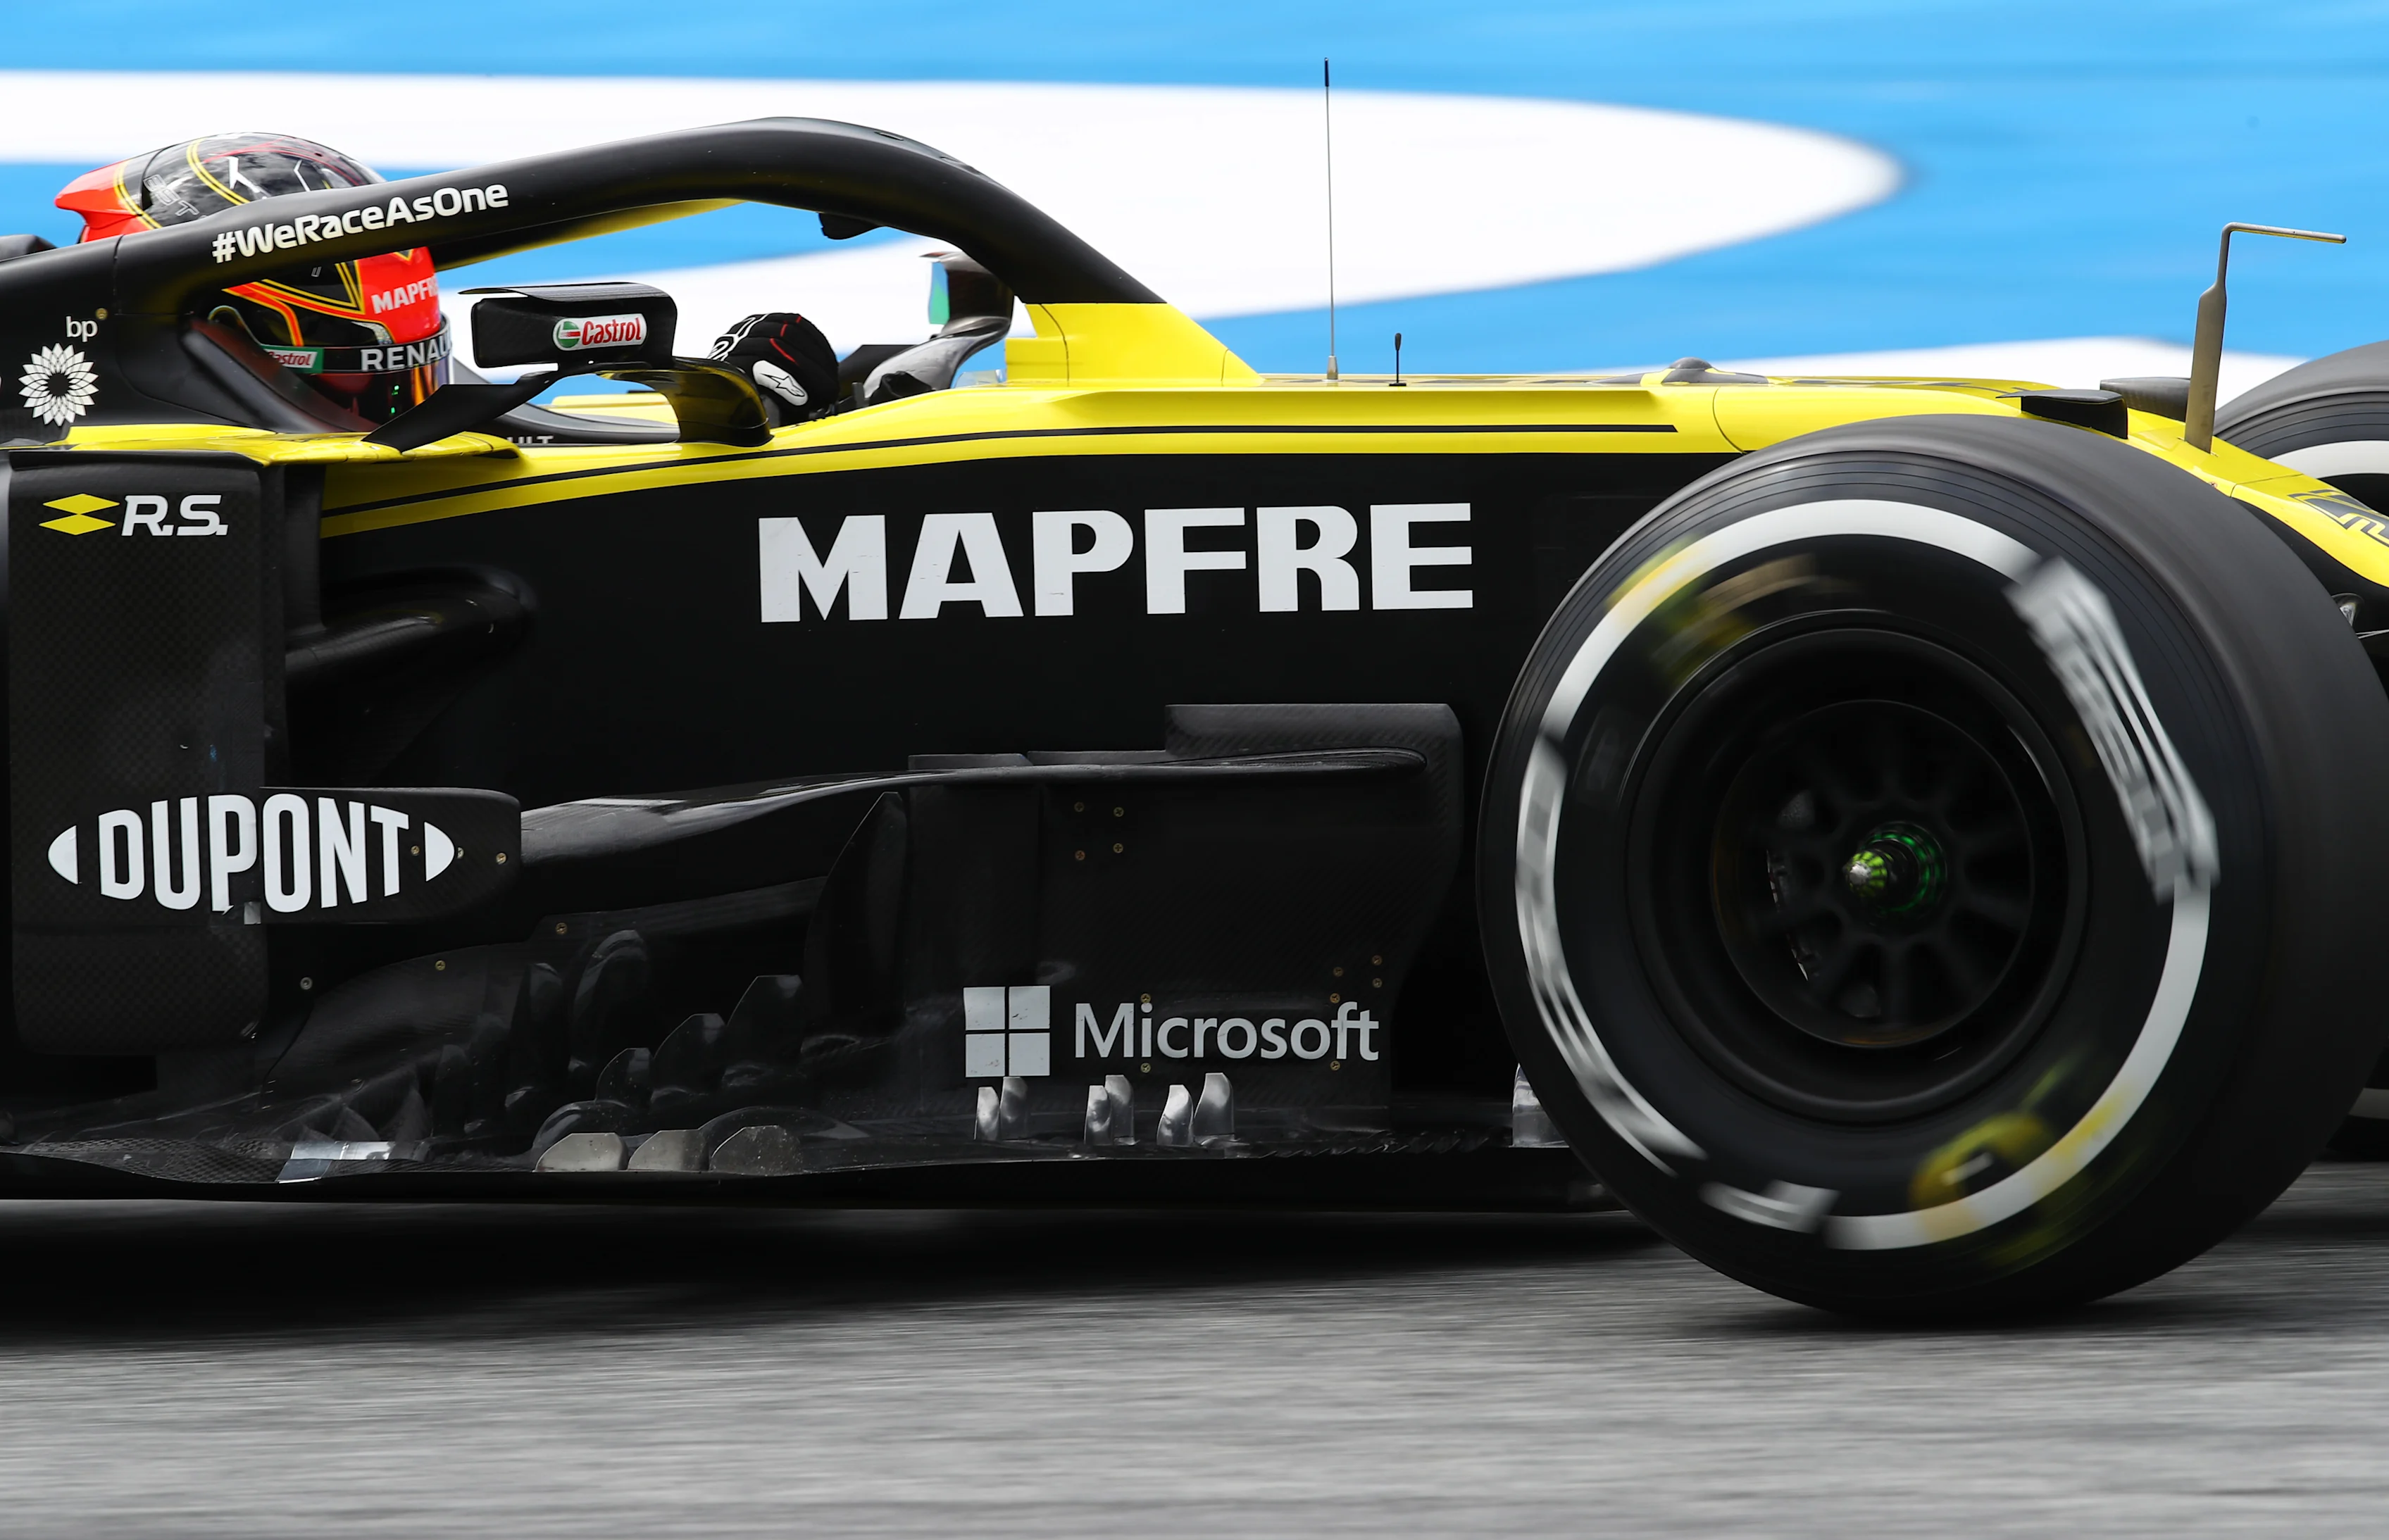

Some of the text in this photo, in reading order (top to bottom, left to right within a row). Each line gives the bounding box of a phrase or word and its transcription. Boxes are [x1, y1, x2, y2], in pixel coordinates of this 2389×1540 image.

[212, 184, 509, 263] #WeRaceAsOne
[66, 315, 99, 343] bp
[582, 317, 641, 346] Castrol
[121, 494, 229, 537] R.S.
[759, 502, 1473, 623] MAPFRE
[98, 793, 410, 915] DUPONT
[1075, 1001, 1379, 1061] Microsoft
